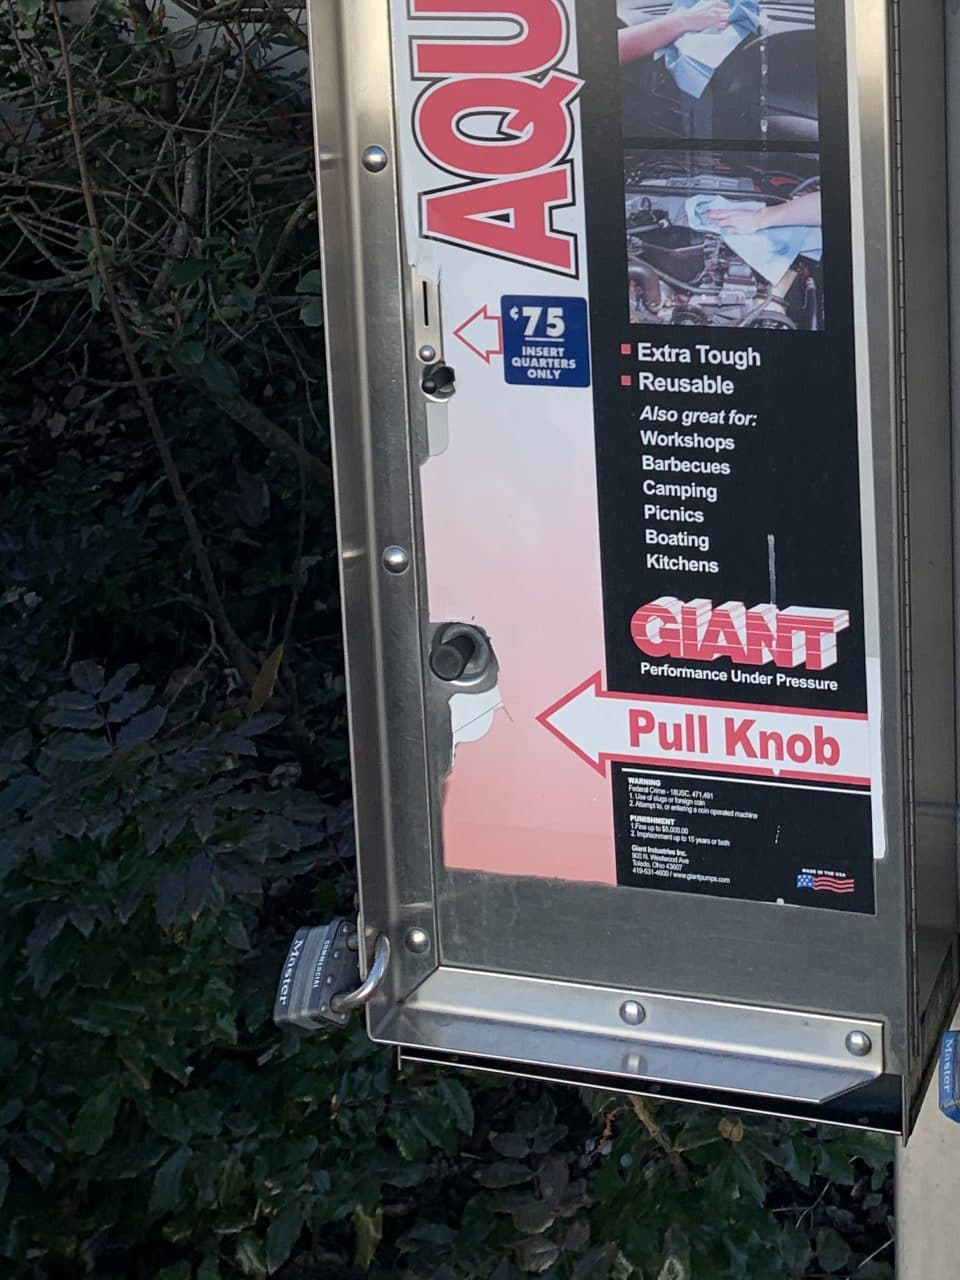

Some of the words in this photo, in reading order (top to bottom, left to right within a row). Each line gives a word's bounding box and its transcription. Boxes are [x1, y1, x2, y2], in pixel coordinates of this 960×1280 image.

[521, 346, 565, 357] INSERT
[637, 342, 691, 363] Extra
[695, 344, 761, 370] Tough
[511, 357, 577, 369] QUARTERS
[526, 368, 562, 380] ONLY
[638, 372, 735, 395] Reusable
[639, 405, 678, 422] Also
[682, 409, 725, 426] great
[728, 410, 758, 426] for:
[640, 429, 735, 453] Workshops
[641, 455, 731, 475] Barbecues
[642, 480, 718, 502] Camping
[644, 504, 704, 522] Picnics
[645, 529, 709, 551] Boating
[646, 554, 719, 573] Kitchens
[630, 596, 849, 670] GIANT
[640, 661, 728, 682] Performance
[730, 669, 773, 685] Under
[776, 673, 838, 691] Pressure
[628, 708, 708, 754] Pull
[724, 716, 840, 766] Knob
[628, 777, 661, 787] WARNING
[630, 815, 676, 826] PUNISHMENT
[631, 844, 647, 853] Giant
[279, 939, 305, 1006] Master
[943, 1038, 955, 1093] Master
